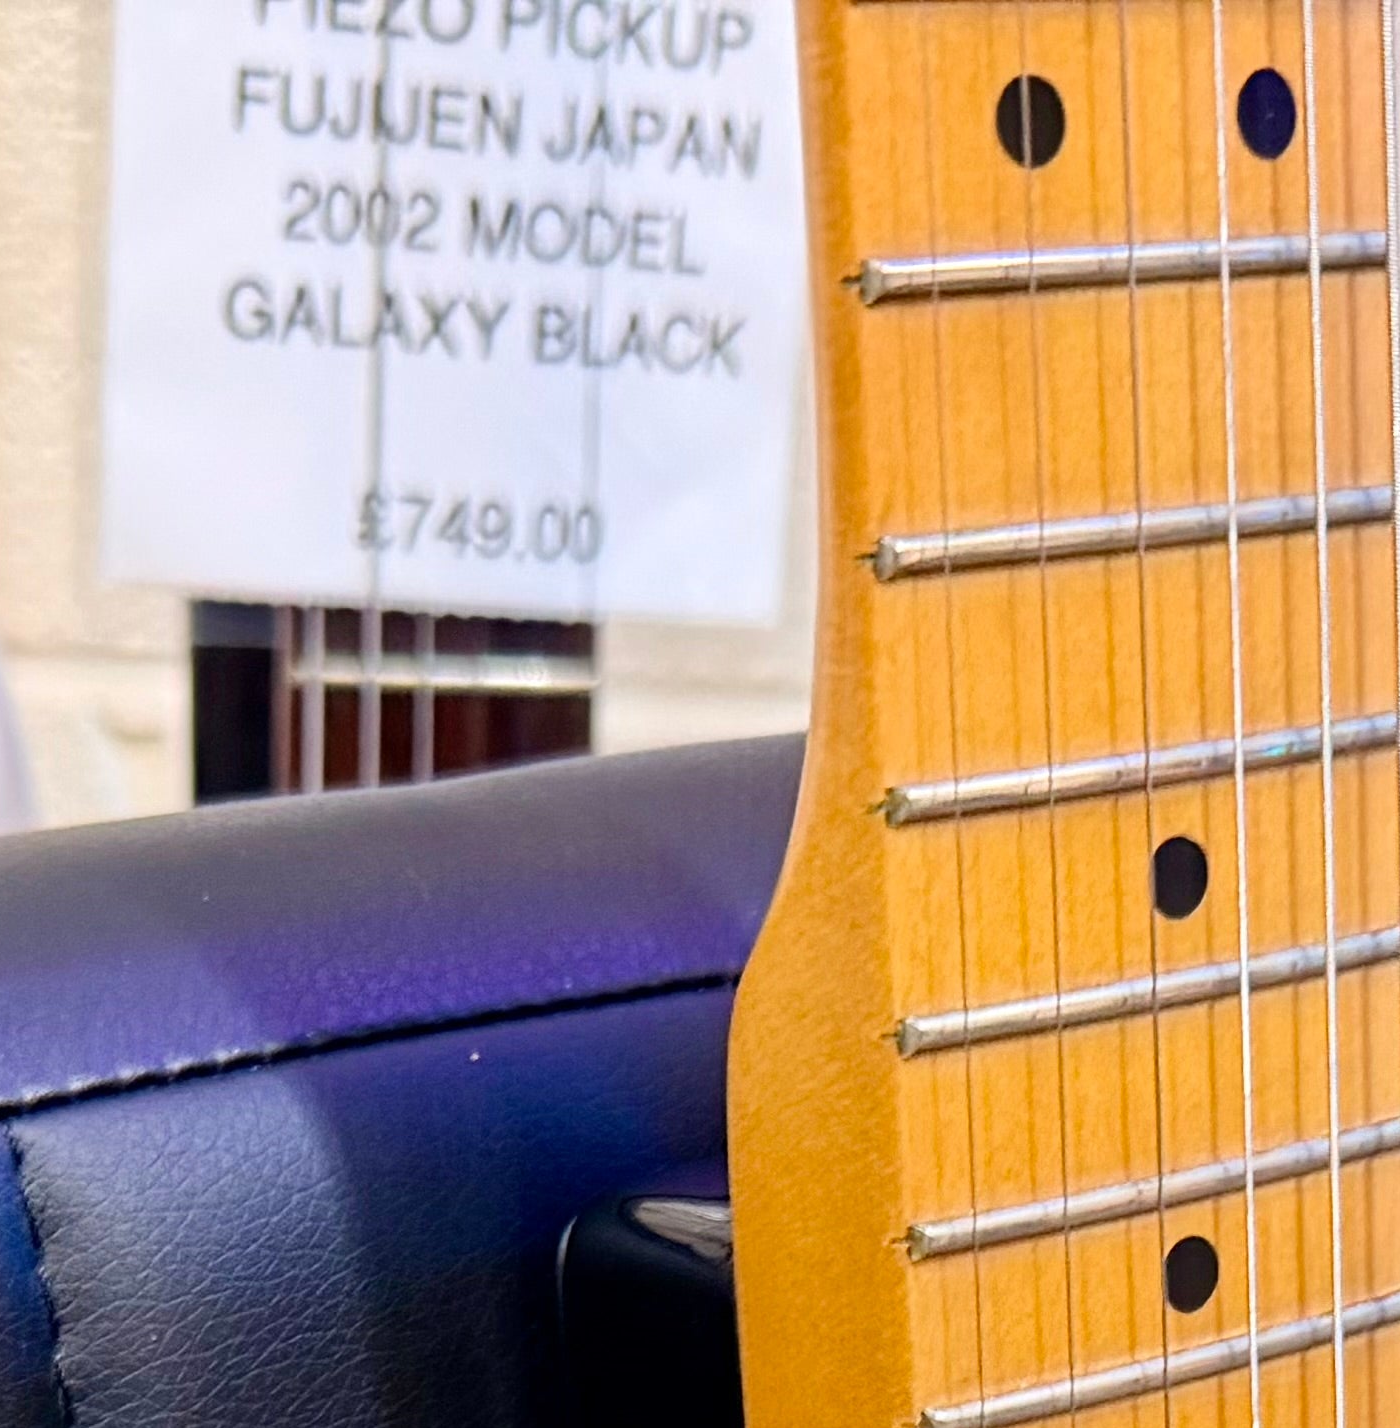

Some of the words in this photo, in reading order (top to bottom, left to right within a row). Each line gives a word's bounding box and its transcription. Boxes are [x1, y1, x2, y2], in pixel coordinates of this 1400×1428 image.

[498, 0, 754, 77] PICKUP
[544, 98, 761, 179] JAPAN
[283, 182, 442, 252] 2002
[465, 196, 705, 276] MODEL
[222, 280, 509, 361] GALAXY
[532, 303, 747, 377] BLACK
[358, 492, 600, 564] £749.00
